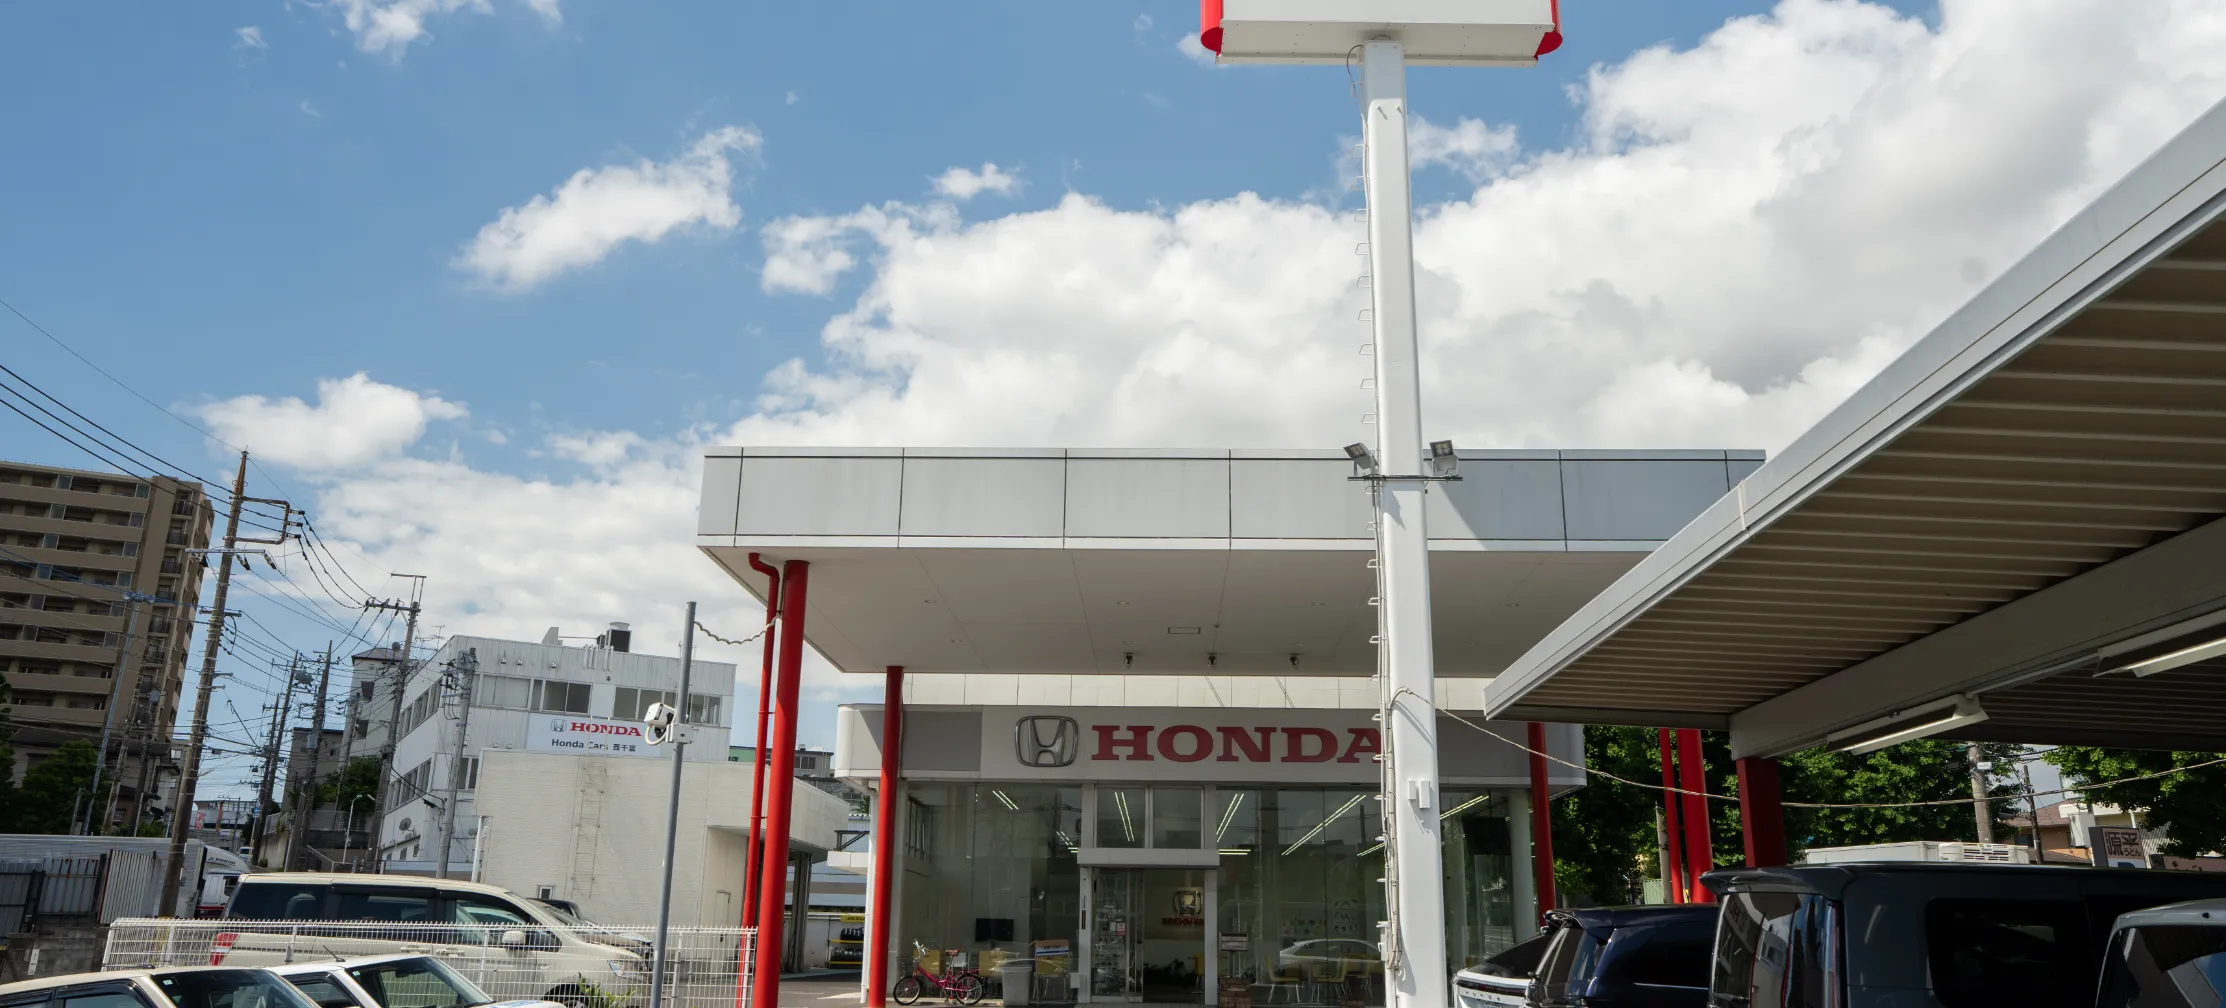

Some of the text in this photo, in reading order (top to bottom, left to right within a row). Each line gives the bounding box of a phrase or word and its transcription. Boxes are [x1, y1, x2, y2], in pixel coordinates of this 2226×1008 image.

[570, 721, 642, 737] HONDA
[551, 738, 585, 749] Honda
[587, 741, 609, 751] Cars
[1091, 724, 1382, 763] HONDA
[2123, 847, 2142, 857] うどん
